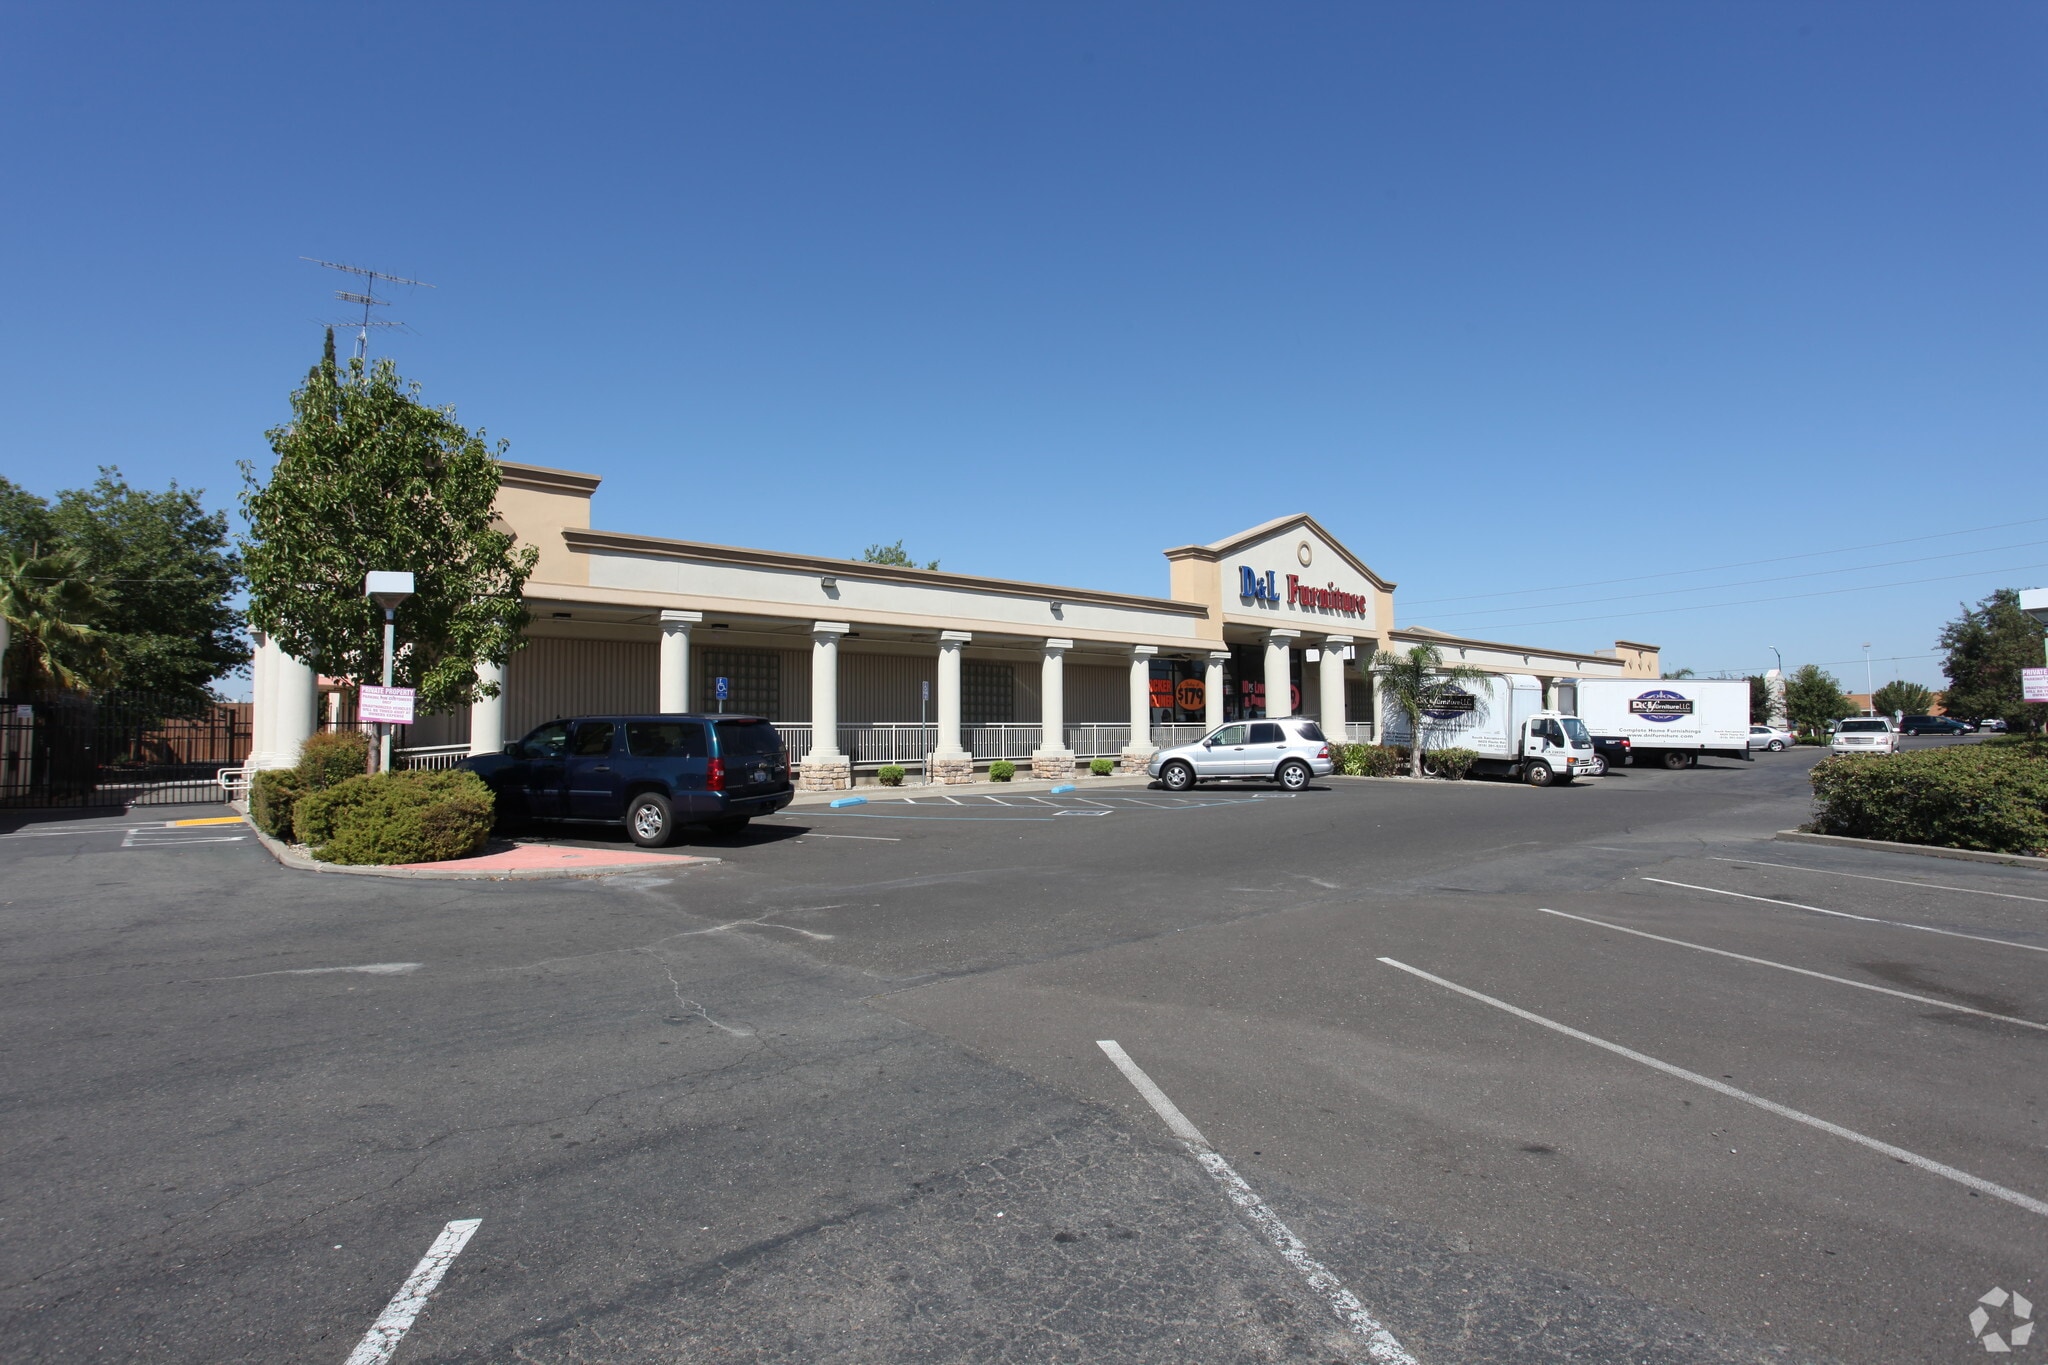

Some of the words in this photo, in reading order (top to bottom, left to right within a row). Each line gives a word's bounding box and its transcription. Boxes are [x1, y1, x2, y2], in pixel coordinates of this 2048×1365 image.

[1239, 565, 1280, 602] D&L
[1286, 574, 1366, 614] Furniture
[362, 687, 384, 695] PRIVATE
[386, 688, 413, 696] PROPERTY
[1178, 687, 1203, 705] $179
